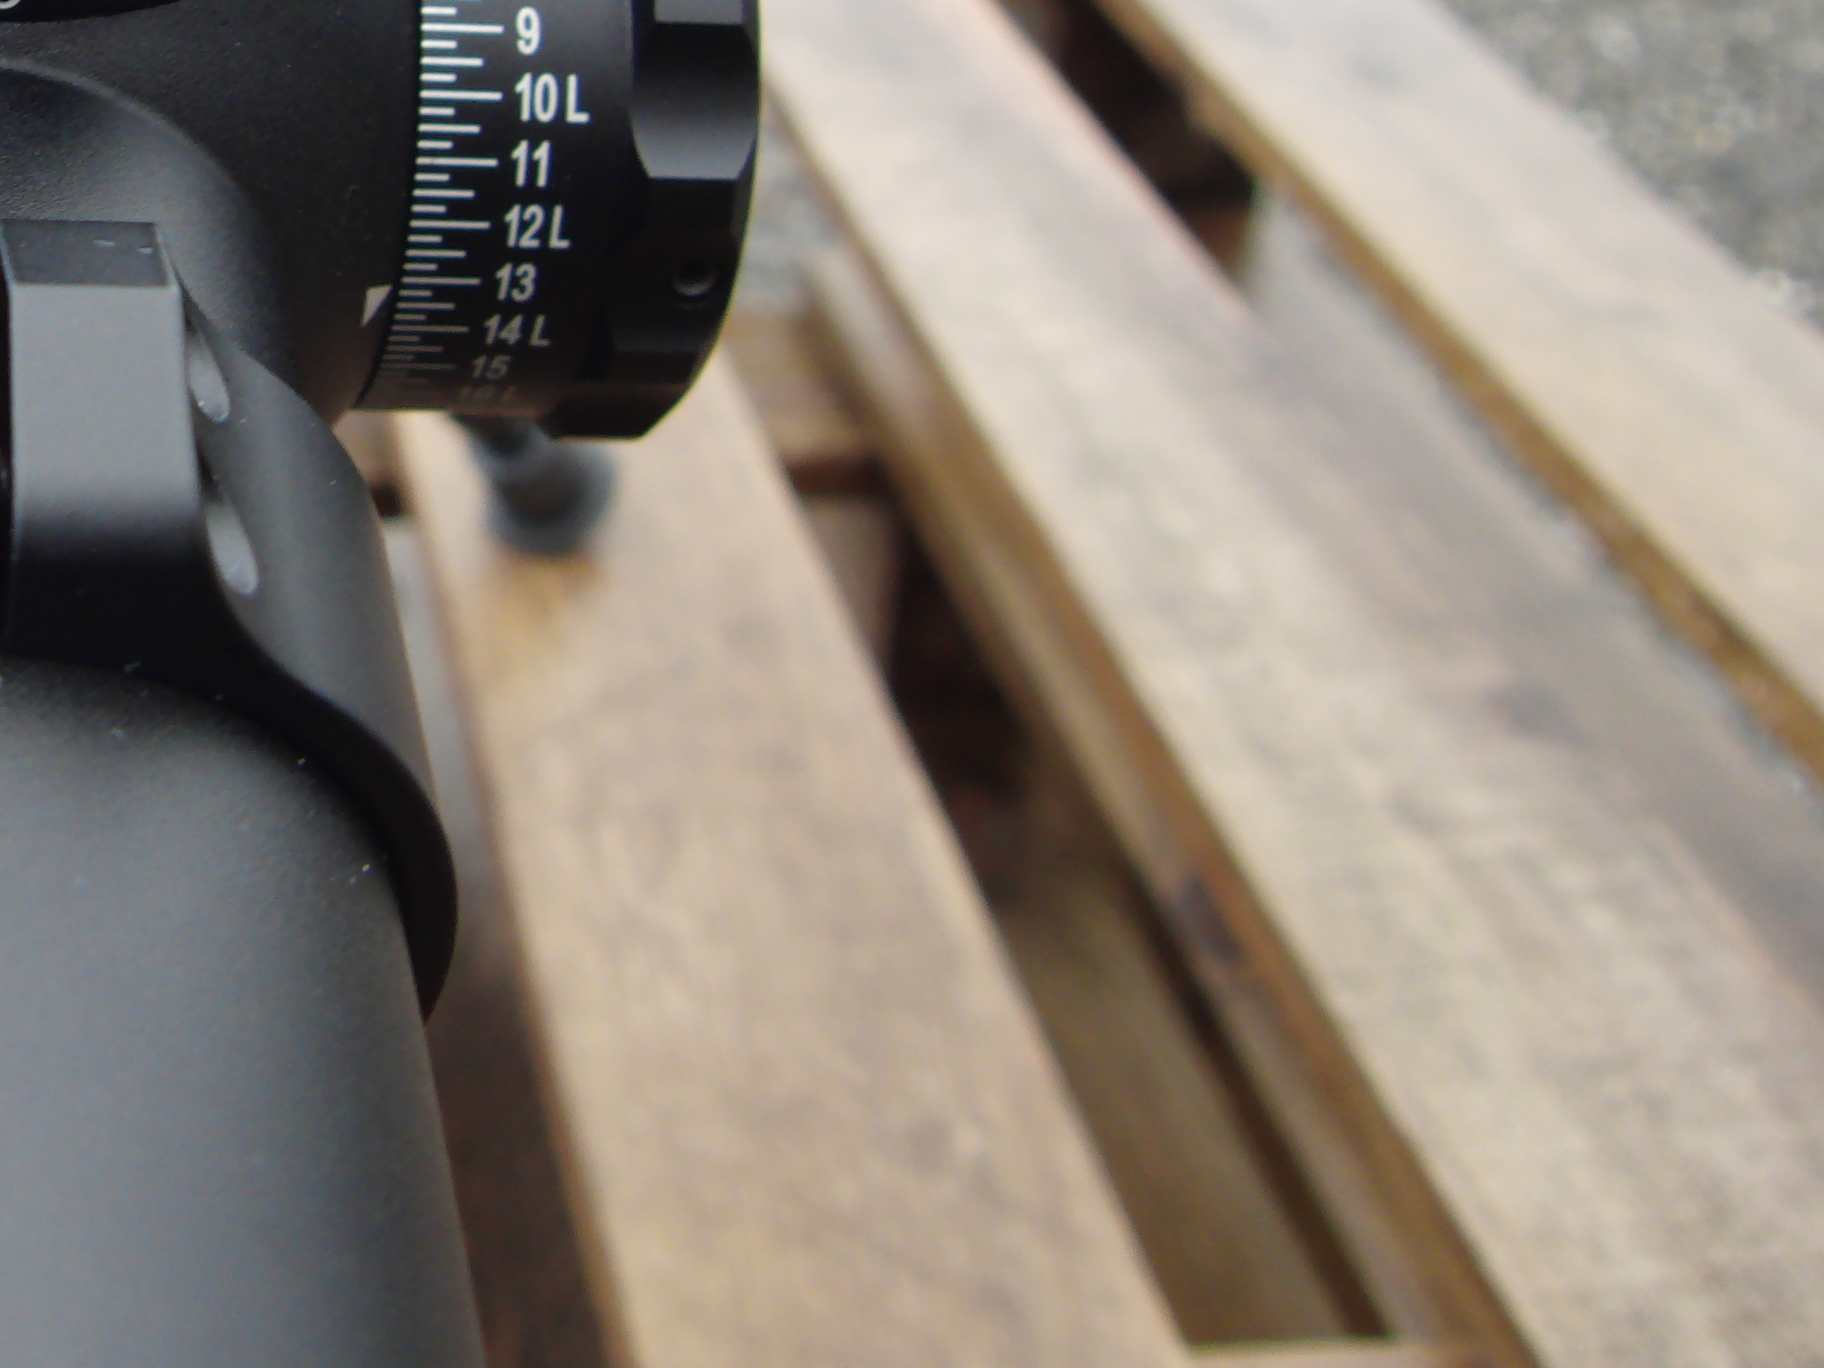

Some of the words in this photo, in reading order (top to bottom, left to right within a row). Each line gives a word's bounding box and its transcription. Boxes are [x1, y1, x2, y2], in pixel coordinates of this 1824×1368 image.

[516, 7, 541, 55] 9
[511, 139, 551, 188] 11
[495, 261, 537, 302] 13
[471, 354, 512, 380] 15
